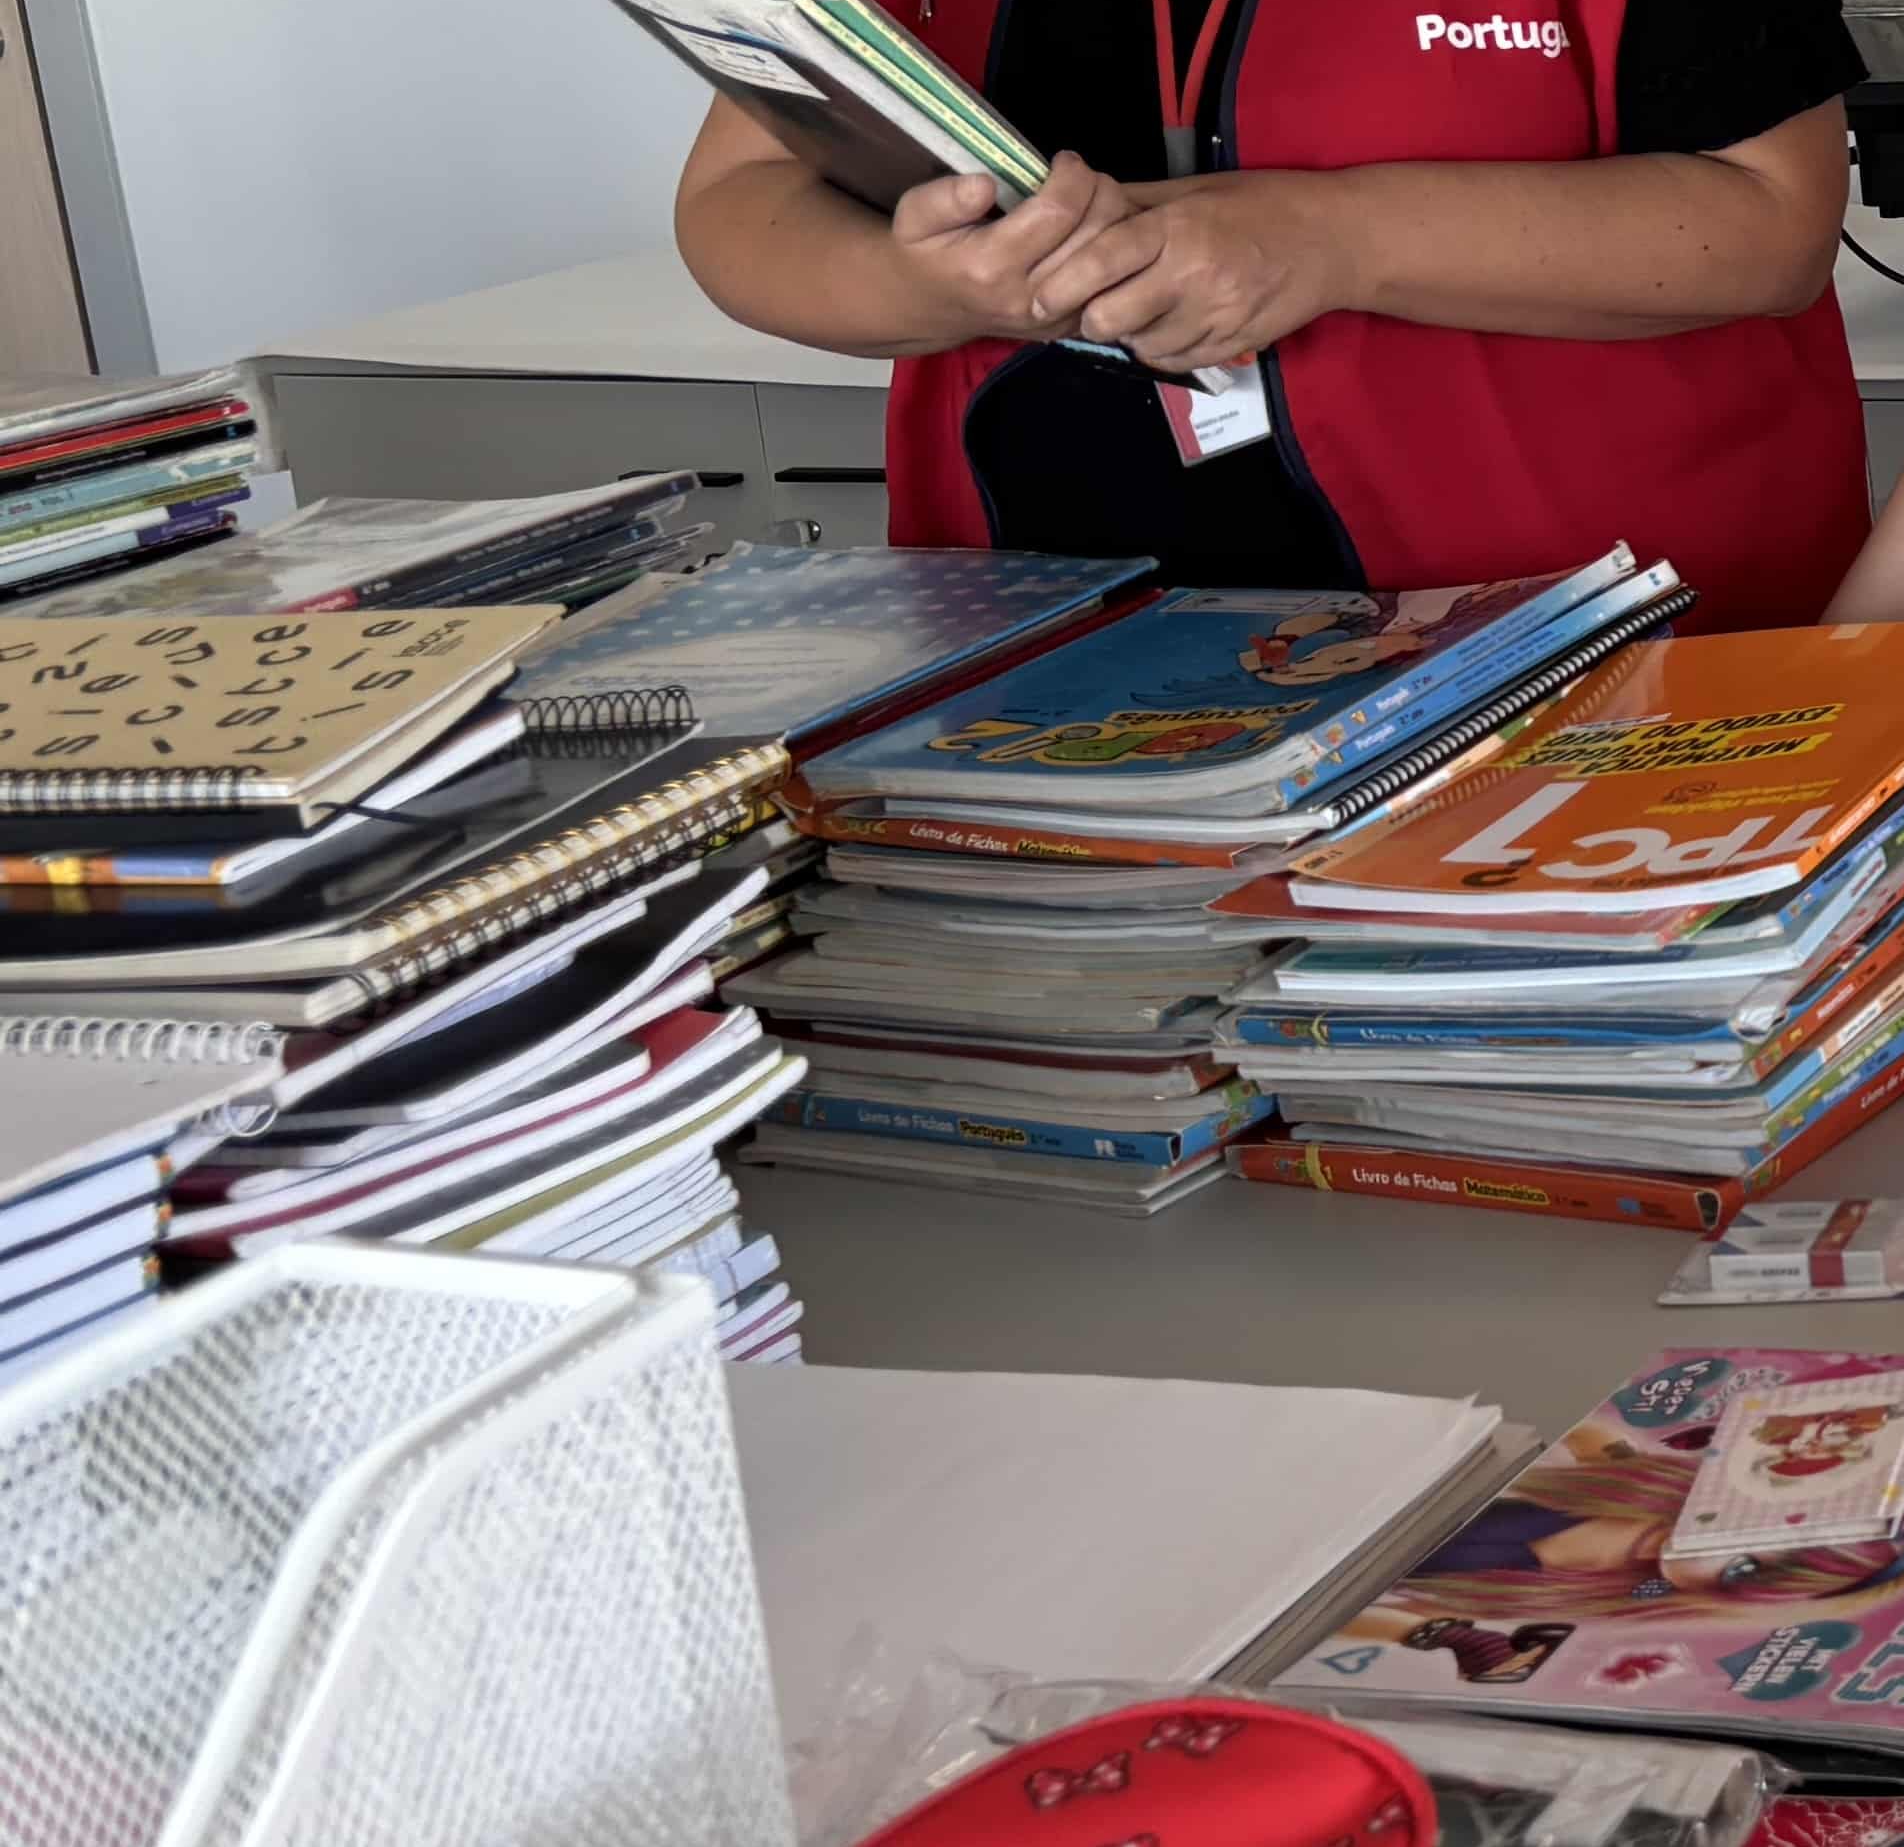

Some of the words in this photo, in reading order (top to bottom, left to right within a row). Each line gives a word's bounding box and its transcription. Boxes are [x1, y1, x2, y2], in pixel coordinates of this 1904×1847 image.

[1415, 14, 1571, 59] Portug
[1651, 721, 1696, 740] DO
[1702, 704, 1838, 735] ESTUDO
[1537, 804, 1836, 881] TPC
[1353, 1167, 1391, 1188] Livro
[1392, 1170, 1411, 1189] de
[1412, 1171, 1459, 1194] Fichas
[1465, 1179, 1549, 1204] Matemática
